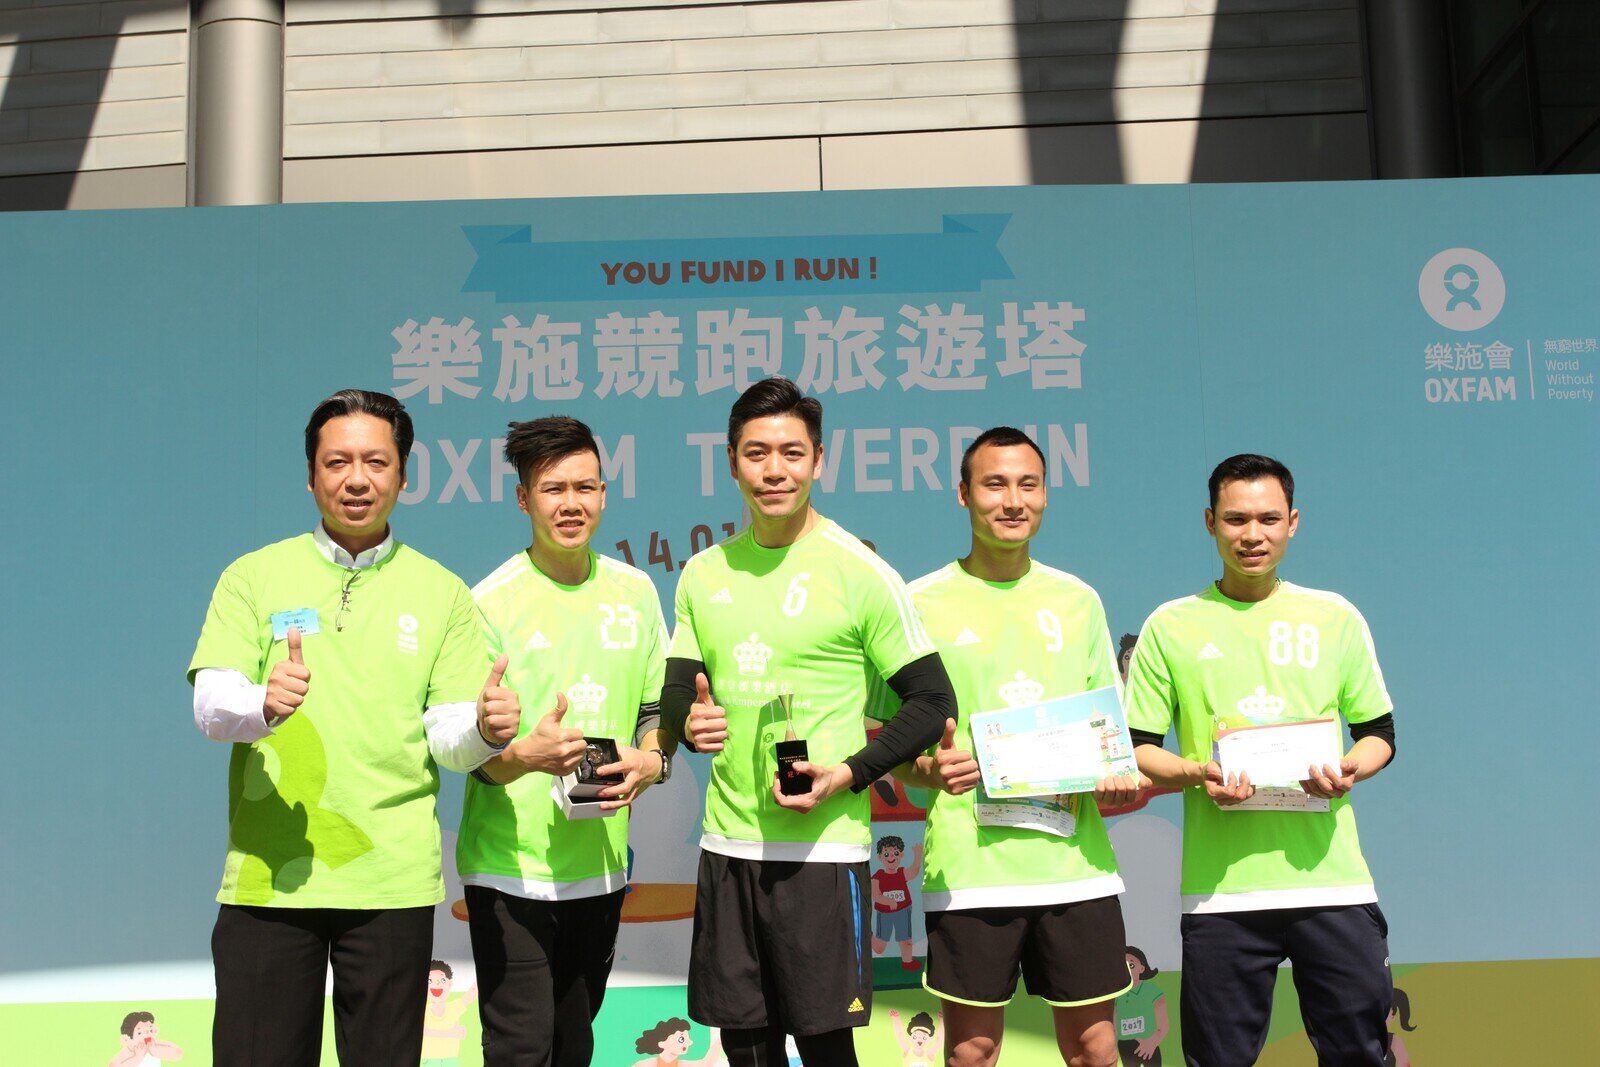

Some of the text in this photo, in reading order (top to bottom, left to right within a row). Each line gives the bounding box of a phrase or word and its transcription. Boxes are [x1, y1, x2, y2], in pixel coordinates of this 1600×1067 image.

[601, 262, 671, 286] YOU
[681, 259, 767, 284] FUND
[775, 259, 785, 282] I
[390, 301, 1088, 405] 樂施競跑旅遊塔
[1424, 340, 1515, 372] 樂施會
[1545, 359, 1580, 371] World
[1424, 376, 1518, 403] OXFAM
[1546, 373, 1594, 385] Without
[1548, 388, 1594, 402] Poverty
[397, 434, 636, 505] OXFM
[782, 572, 811, 616] 6
[598, 603, 638, 649] 23
[1036, 608, 1062, 653] 9
[1268, 620, 1319, 669] 88
[1122, 1020, 1142, 1031] 2017
